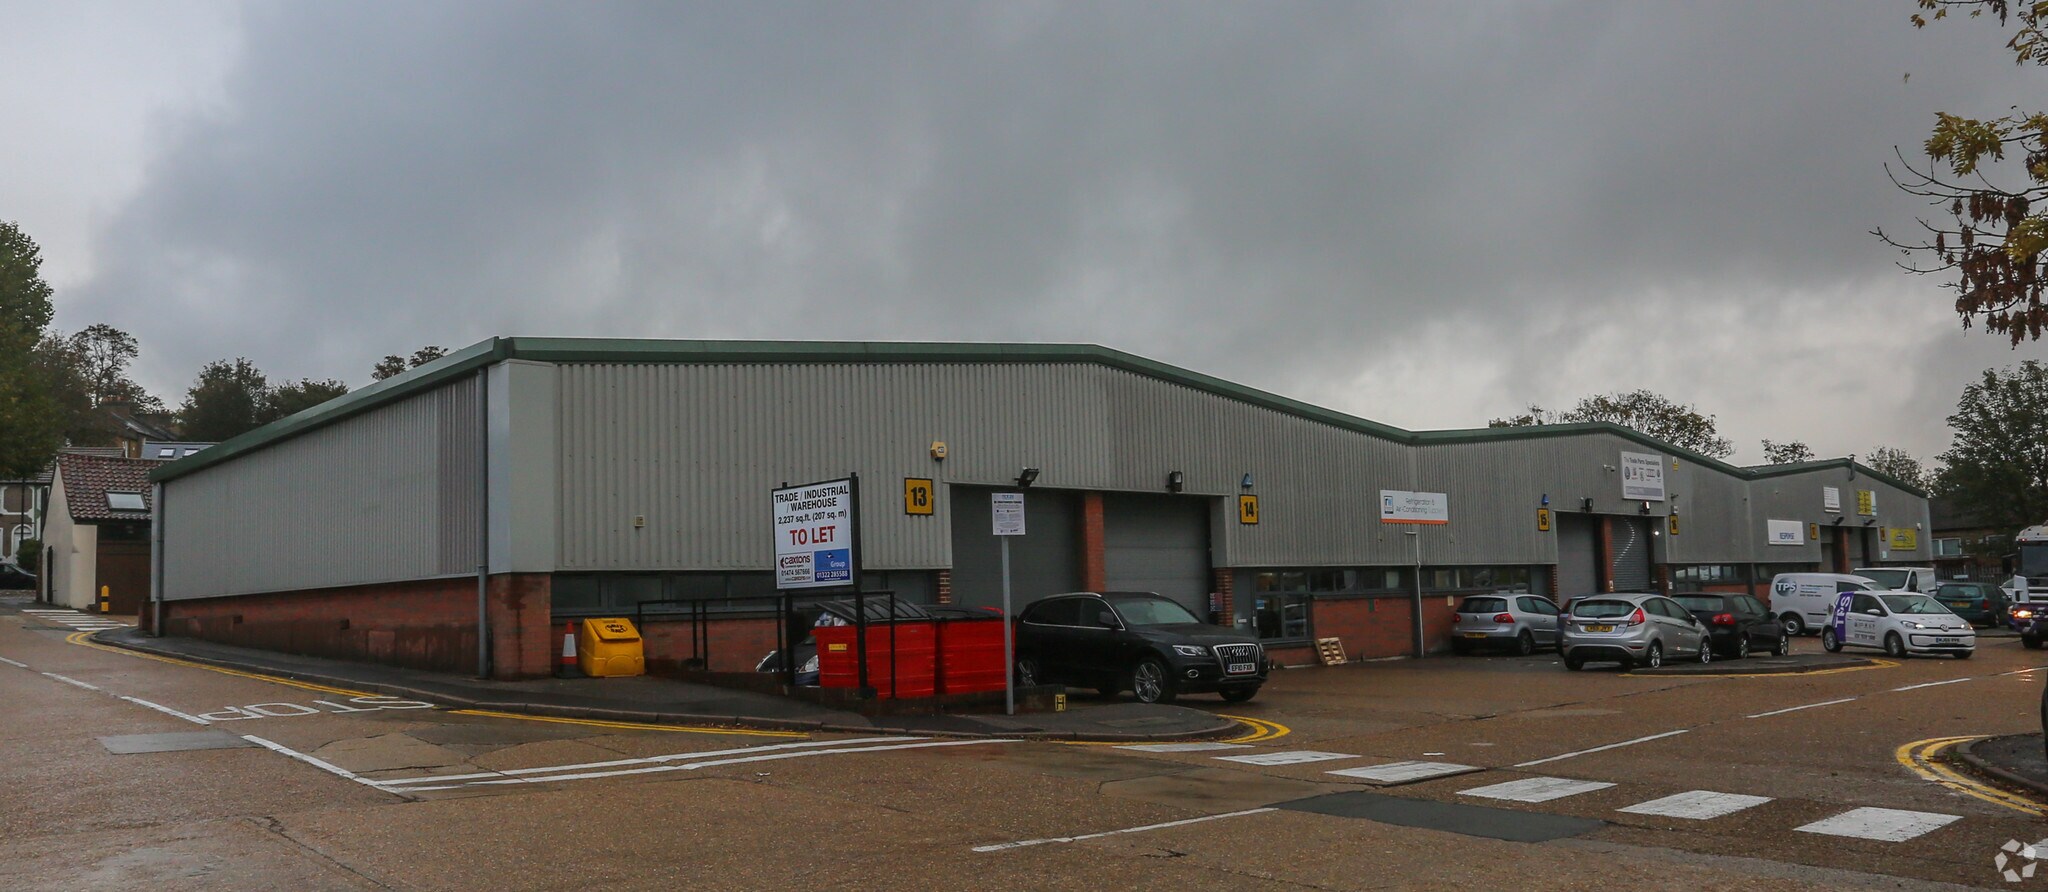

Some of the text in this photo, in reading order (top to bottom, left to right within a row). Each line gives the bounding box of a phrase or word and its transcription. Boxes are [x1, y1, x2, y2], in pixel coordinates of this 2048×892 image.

[775, 492, 798, 503] TRADE
[804, 485, 848, 499] INDUSTRIAL
[910, 486, 927, 507] 13
[790, 497, 837, 512] WAREHOUSE
[1243, 501, 1255, 517] 14
[778, 515, 794, 525] 2,237
[812, 511, 826, 522] (207
[827, 512, 837, 520] sq.
[838, 508, 847, 519] m)
[1540, 514, 1547, 525] 15
[789, 526, 836, 545] TO LET
[784, 555, 811, 565] caxtons
[830, 560, 846, 568] Group
[816, 571, 830, 579] 01322
[1776, 582, 1797, 591] TPS
